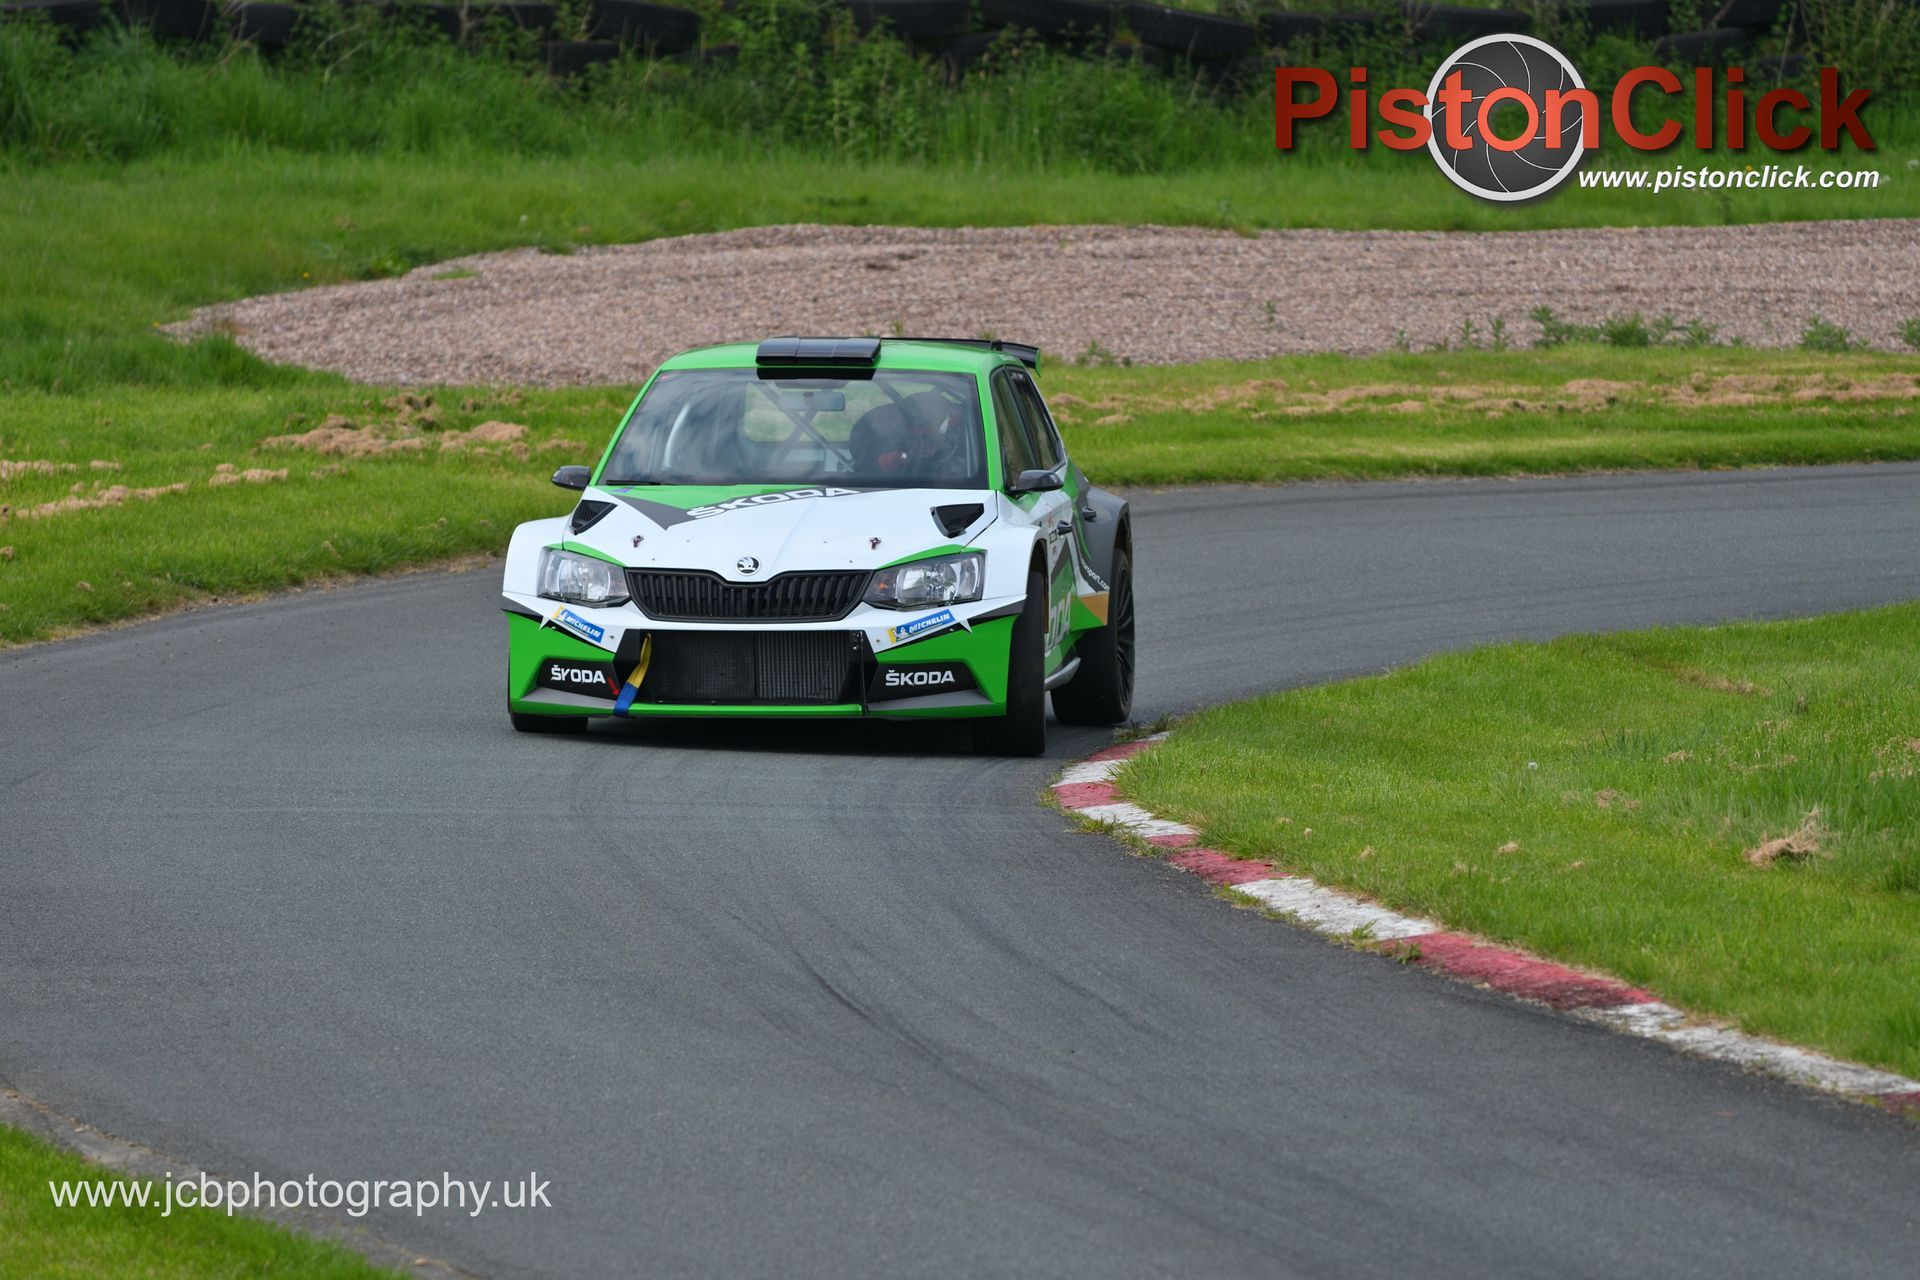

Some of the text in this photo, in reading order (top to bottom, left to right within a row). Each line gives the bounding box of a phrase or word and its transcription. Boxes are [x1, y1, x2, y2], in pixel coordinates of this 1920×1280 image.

[565, 616, 602, 638] MICHELIN
[909, 613, 951, 634] MICHELIN
[885, 669, 956, 687] ŠKODA
